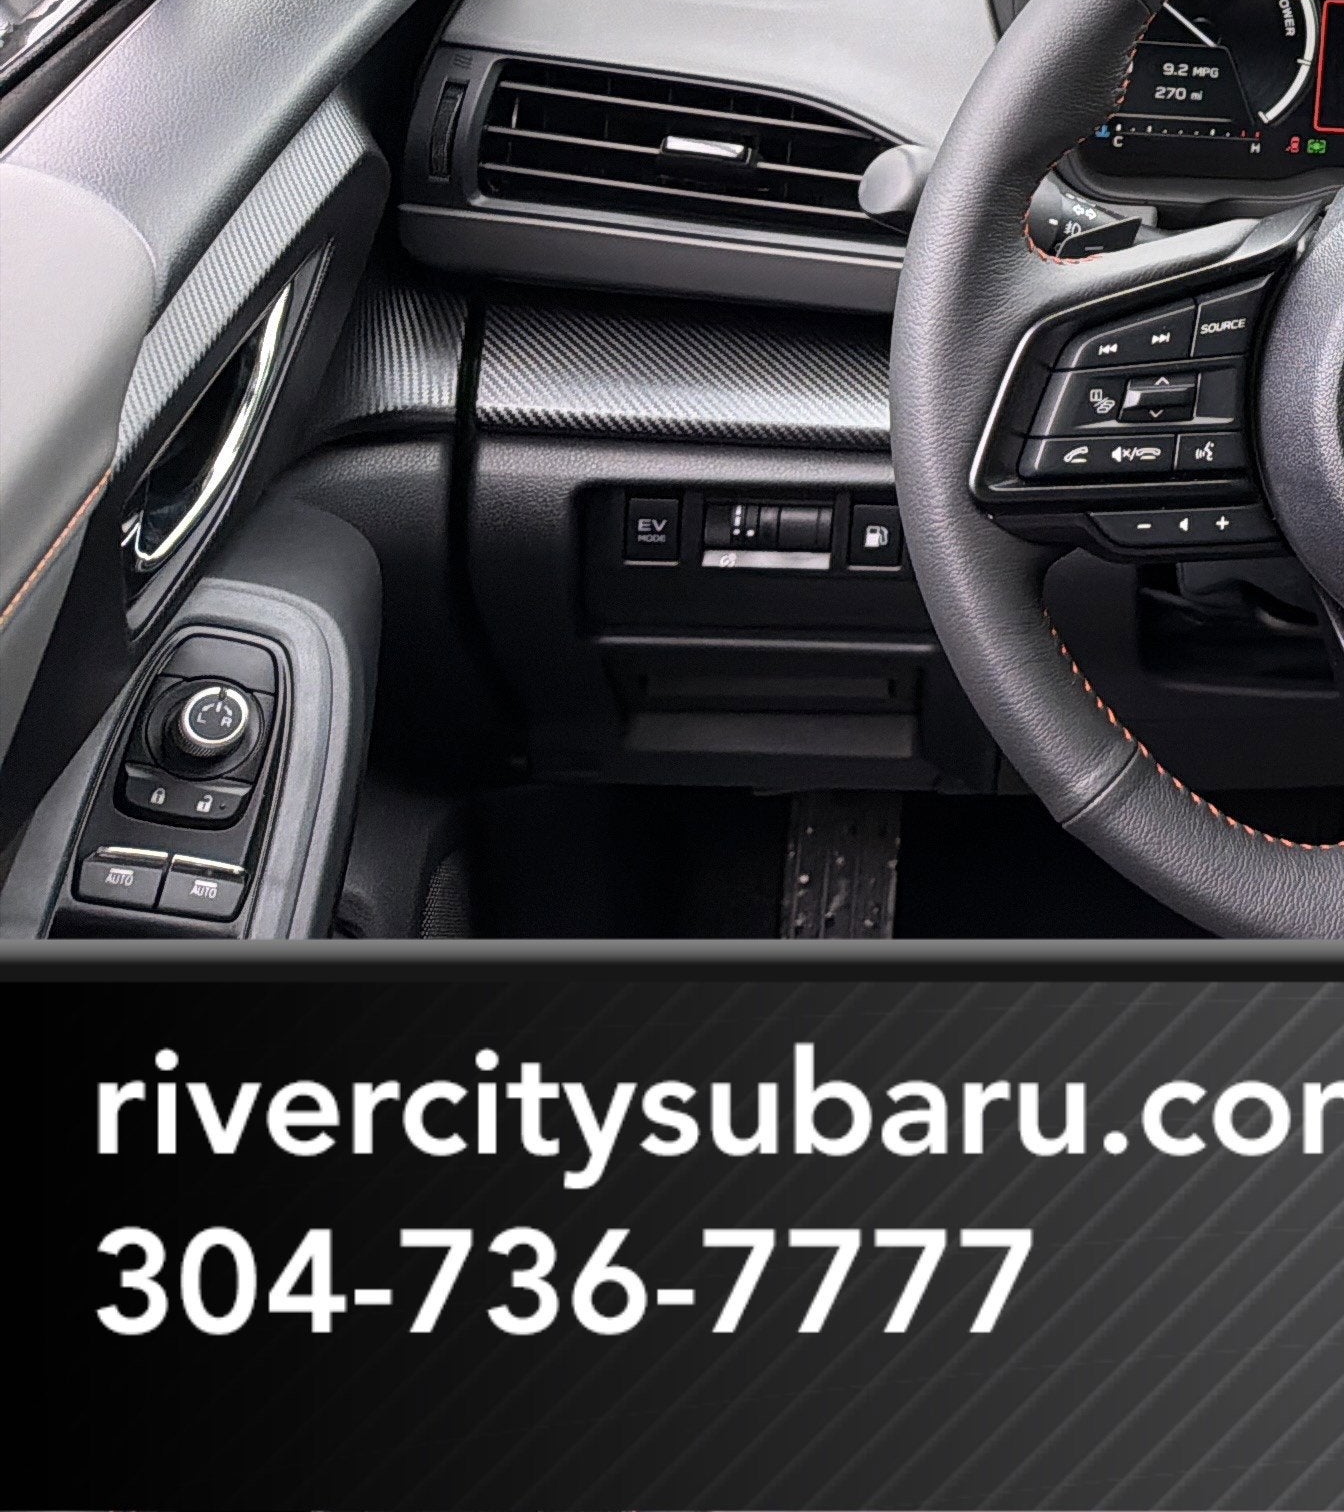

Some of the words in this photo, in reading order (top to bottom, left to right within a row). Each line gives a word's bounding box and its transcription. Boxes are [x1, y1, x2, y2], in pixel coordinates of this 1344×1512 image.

[1162, 63, 1189, 77] 9.2
[1192, 66, 1219, 79] MPG
[1154, 87, 1187, 101] 270
[1112, 136, 1123, 148] C
[1250, 143, 1261, 154] H
[1200, 317, 1246, 335] SOURCE
[637, 518, 668, 532] EV
[637, 533, 666, 543] MODE
[197, 711, 206, 724] L
[220, 716, 233, 727] R
[105, 871, 134, 886] AUTO
[190, 885, 218, 899] AUTO
